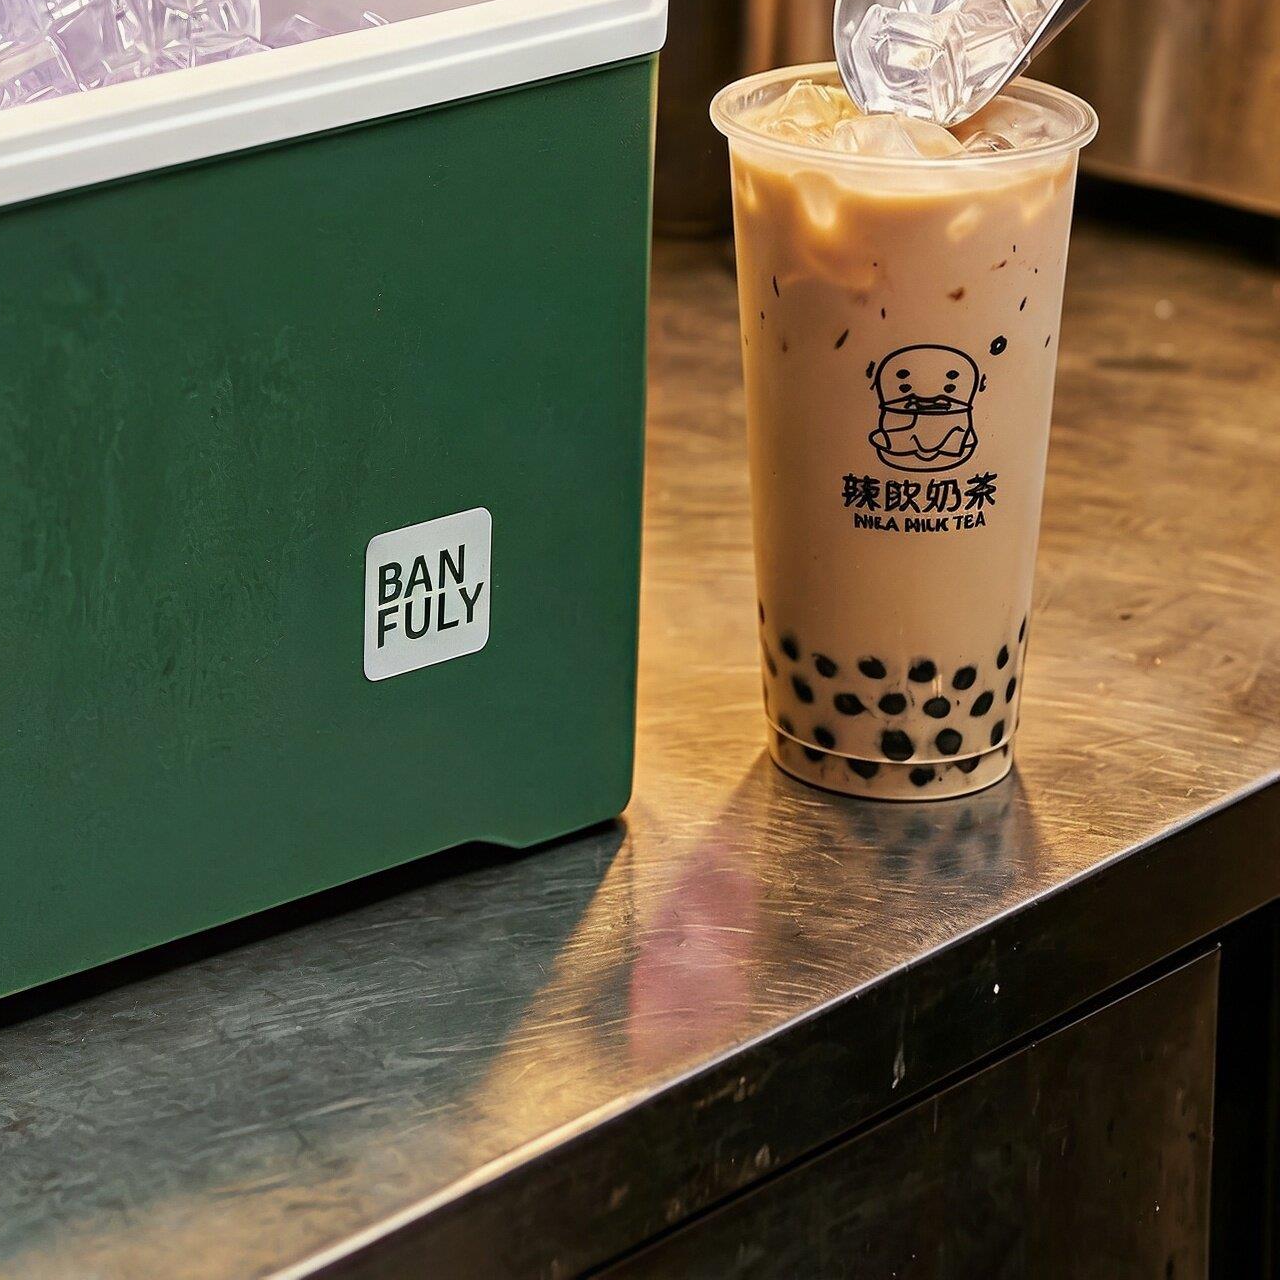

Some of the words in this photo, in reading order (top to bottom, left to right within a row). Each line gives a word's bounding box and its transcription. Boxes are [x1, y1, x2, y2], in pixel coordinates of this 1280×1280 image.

[952, 511, 986, 531] TEA
[378, 544, 466, 606] BAN
[377, 582, 485, 649] FULY
